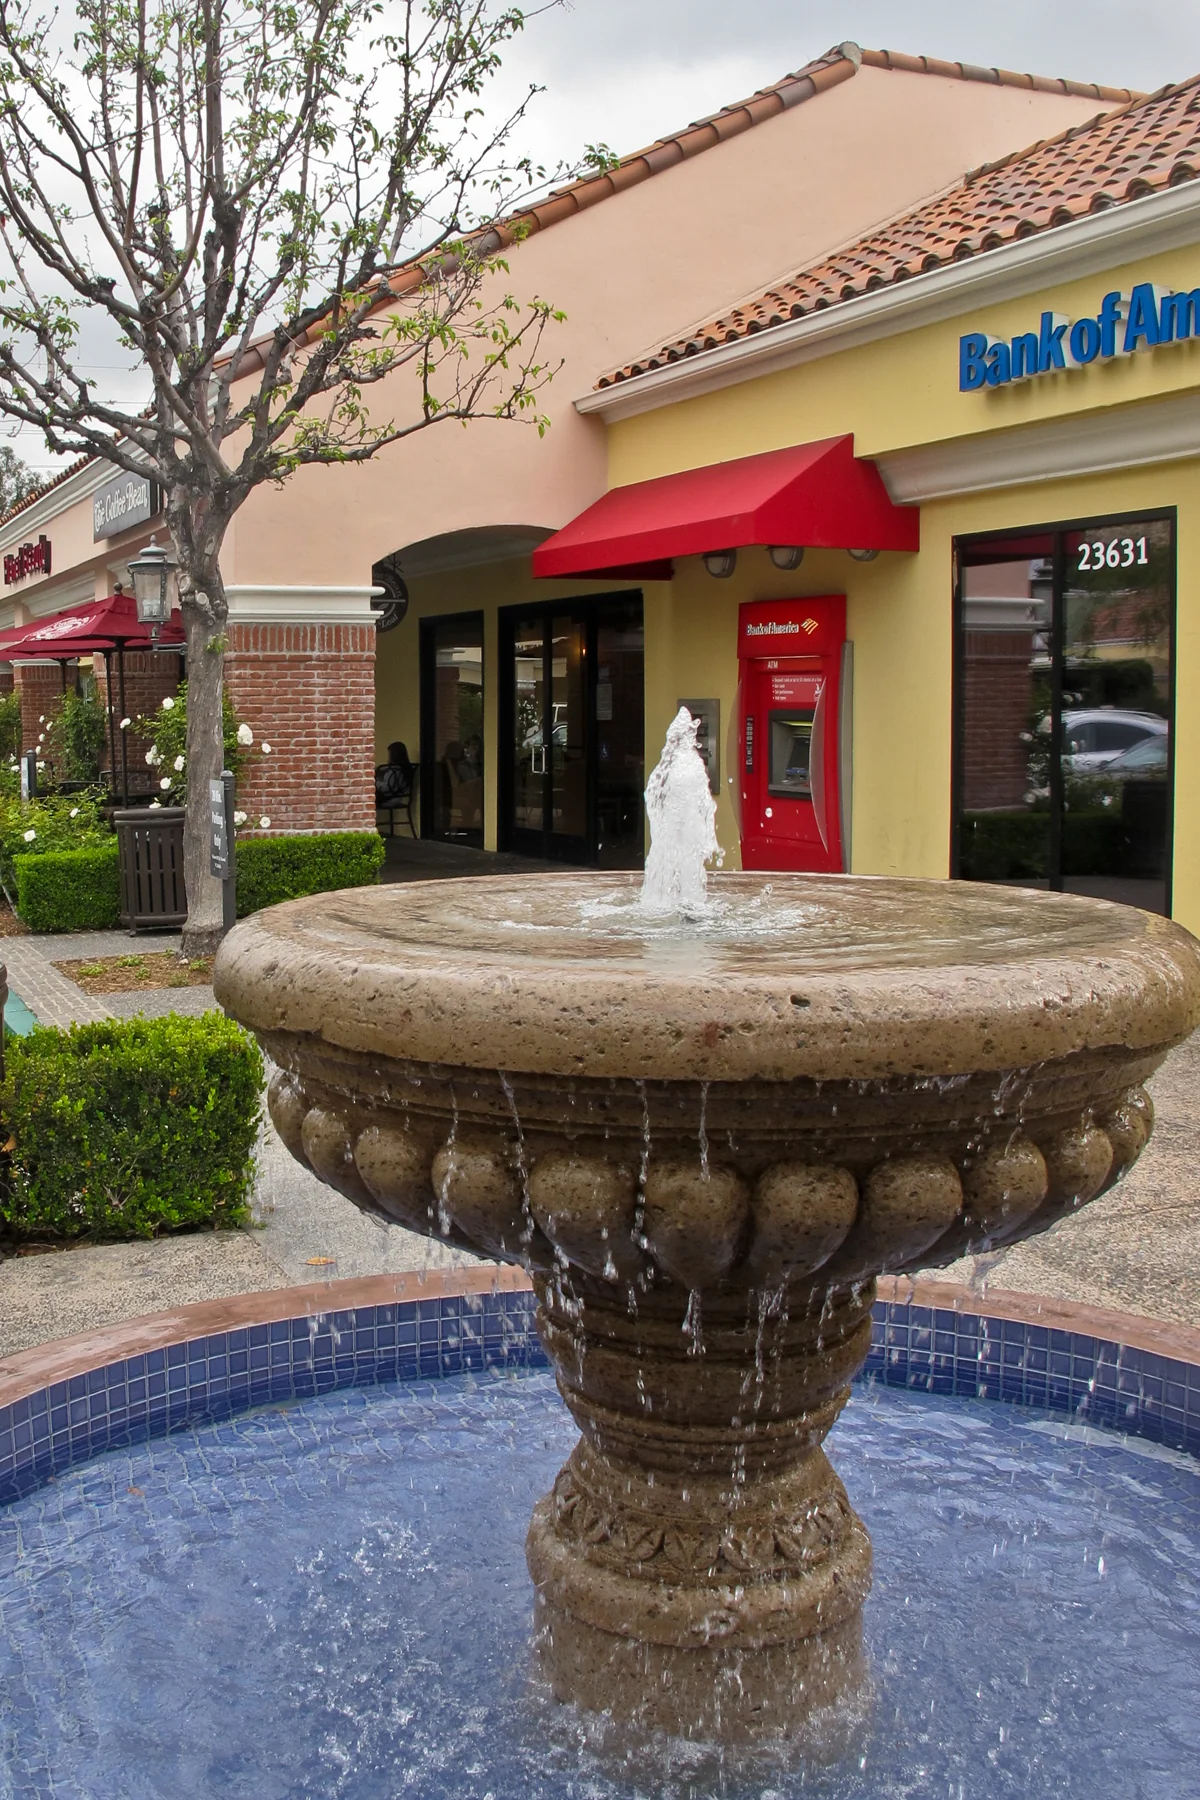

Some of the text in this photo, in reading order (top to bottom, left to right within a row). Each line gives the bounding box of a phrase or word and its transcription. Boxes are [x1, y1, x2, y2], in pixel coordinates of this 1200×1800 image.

[959, 311, 1069, 392] Bank
[1069, 291, 1122, 364] of
[94, 481, 148, 532] The Coffee Bean
[1077, 536, 1149, 571] 23631
[747, 621, 799, 636] Bank of America
[767, 660, 779, 669] ATM
